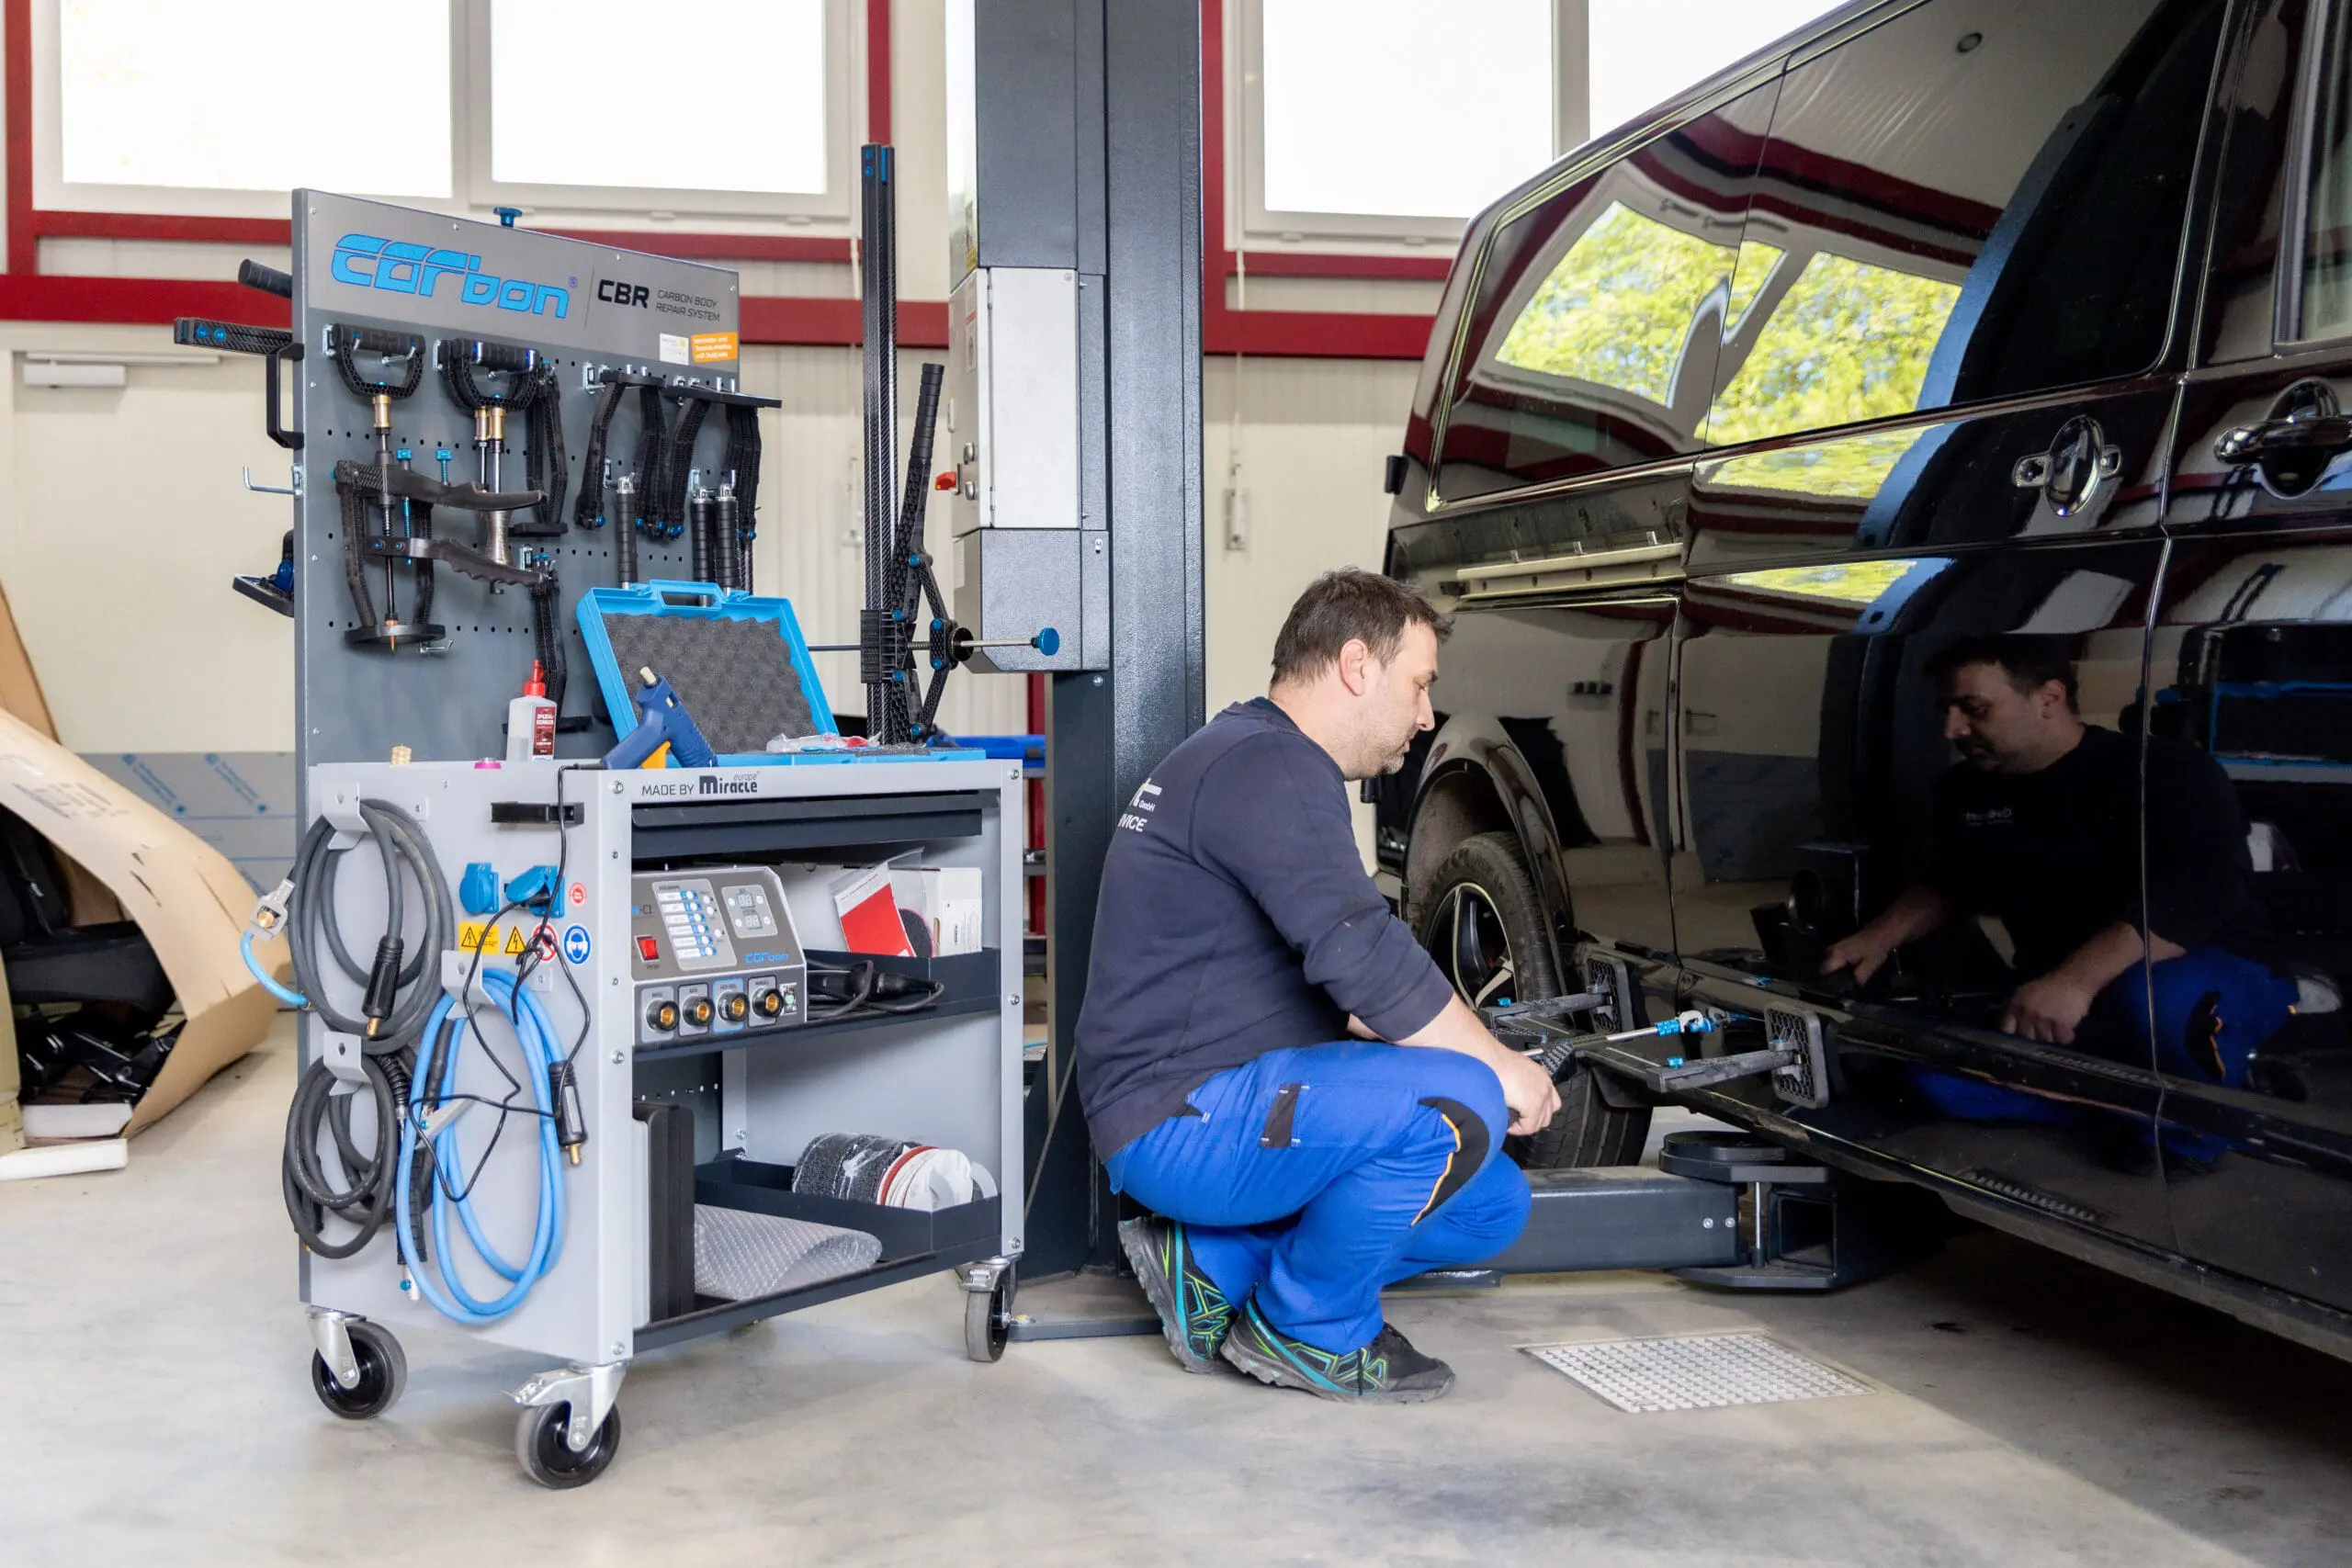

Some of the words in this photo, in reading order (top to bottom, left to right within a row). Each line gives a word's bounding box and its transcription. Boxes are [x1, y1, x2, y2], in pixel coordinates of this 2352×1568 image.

[597, 278, 650, 309] CBR
[657, 289, 693, 304] CARBON
[695, 296, 718, 308] BODY
[656, 302, 686, 316] REPAIR
[688, 308, 720, 321] SYSTEM
[641, 784, 676, 796] MADE
[679, 784, 695, 795] BY
[699, 775, 758, 795] Miracle
[744, 951, 789, 965] carbon
